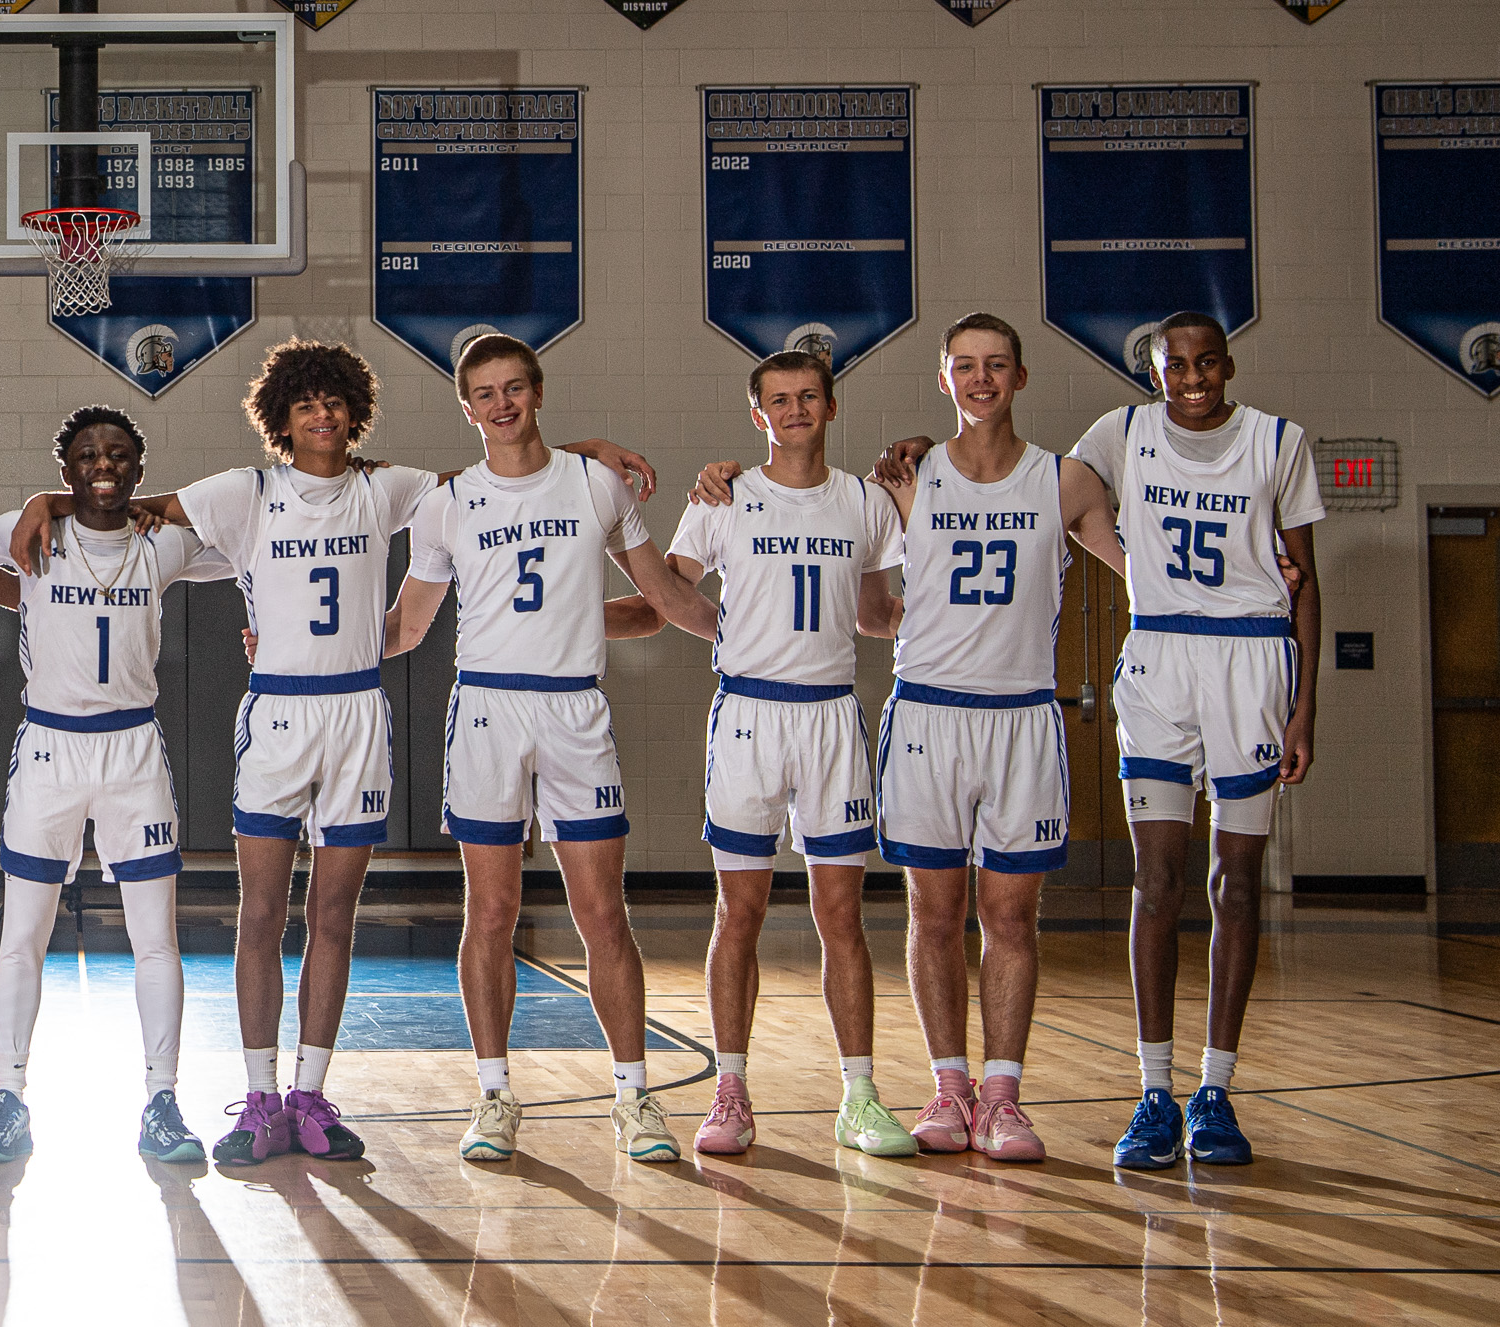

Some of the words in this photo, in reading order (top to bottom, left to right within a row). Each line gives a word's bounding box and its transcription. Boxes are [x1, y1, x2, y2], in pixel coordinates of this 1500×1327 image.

[294, 3, 339, 12] DISTRICT
[622, 2, 668, 11] DISTRICT
[949, 0, 996, 9] DISTRICT
[117, 96, 250, 121] BASKETBALL
[378, 94, 434, 120] BOY'S
[435, 94, 508, 119] INDOOR
[509, 94, 575, 119] TRACK
[708, 92, 769, 118] GIRL'S
[769, 92, 842, 118] INDOOR
[842, 92, 907, 117] TRACK
[1051, 91, 1114, 118] BOY'S
[1115, 90, 1240, 117] SWIMMING
[377, 122, 577, 140] CHAMPIONSHIPS
[707, 120, 909, 139] CHAMPIONSHIPS
[1044, 117, 1249, 138] CHAMPIONSHIPS
[110, 144, 192, 154] DISRICT
[435, 143, 518, 153] DISTRICT
[766, 141, 850, 152] DISTRICT
[1104, 140, 1188, 150] DISTRICT
[157, 158, 195, 172] 1982
[207, 158, 245, 172] 1985
[381, 157, 419, 171] 2011
[711, 156, 750, 170] 2022
[157, 175, 195, 189] 1993
[430, 242, 523, 252] REGIONAL
[763, 240, 855, 251] REGIONAL
[1101, 239, 1196, 250] REGIONAL
[381, 256, 420, 270] 2021
[712, 255, 751, 269] 2020
[1334, 458, 1374, 488] EXIT
[1143, 484, 1191, 509] NEW
[1195, 491, 1251, 514] KENT
[931, 512, 980, 531] NEW
[985, 511, 1040, 531] KENT
[270, 538, 318, 559] NEW
[323, 534, 370, 557] KENT
[477, 523, 524, 551] NEW
[529, 519, 580, 540] KENT
[752, 536, 800, 555] NEW
[805, 536, 855, 559] KENT
[1161, 515, 1228, 588] 35
[513, 546, 545, 613] 5
[949, 539, 1018, 606] 23
[50, 584, 97, 606] NEW
[103, 586, 152, 607] KENT
[309, 566, 340, 637] 3
[791, 564, 821, 633] 11
[96, 616, 110, 685] 1
[360, 790, 386, 814] NK
[594, 784, 623, 810] NK
[843, 797, 873, 824] NK
[143, 821, 174, 848] NK
[1033, 817, 1062, 843] NK
